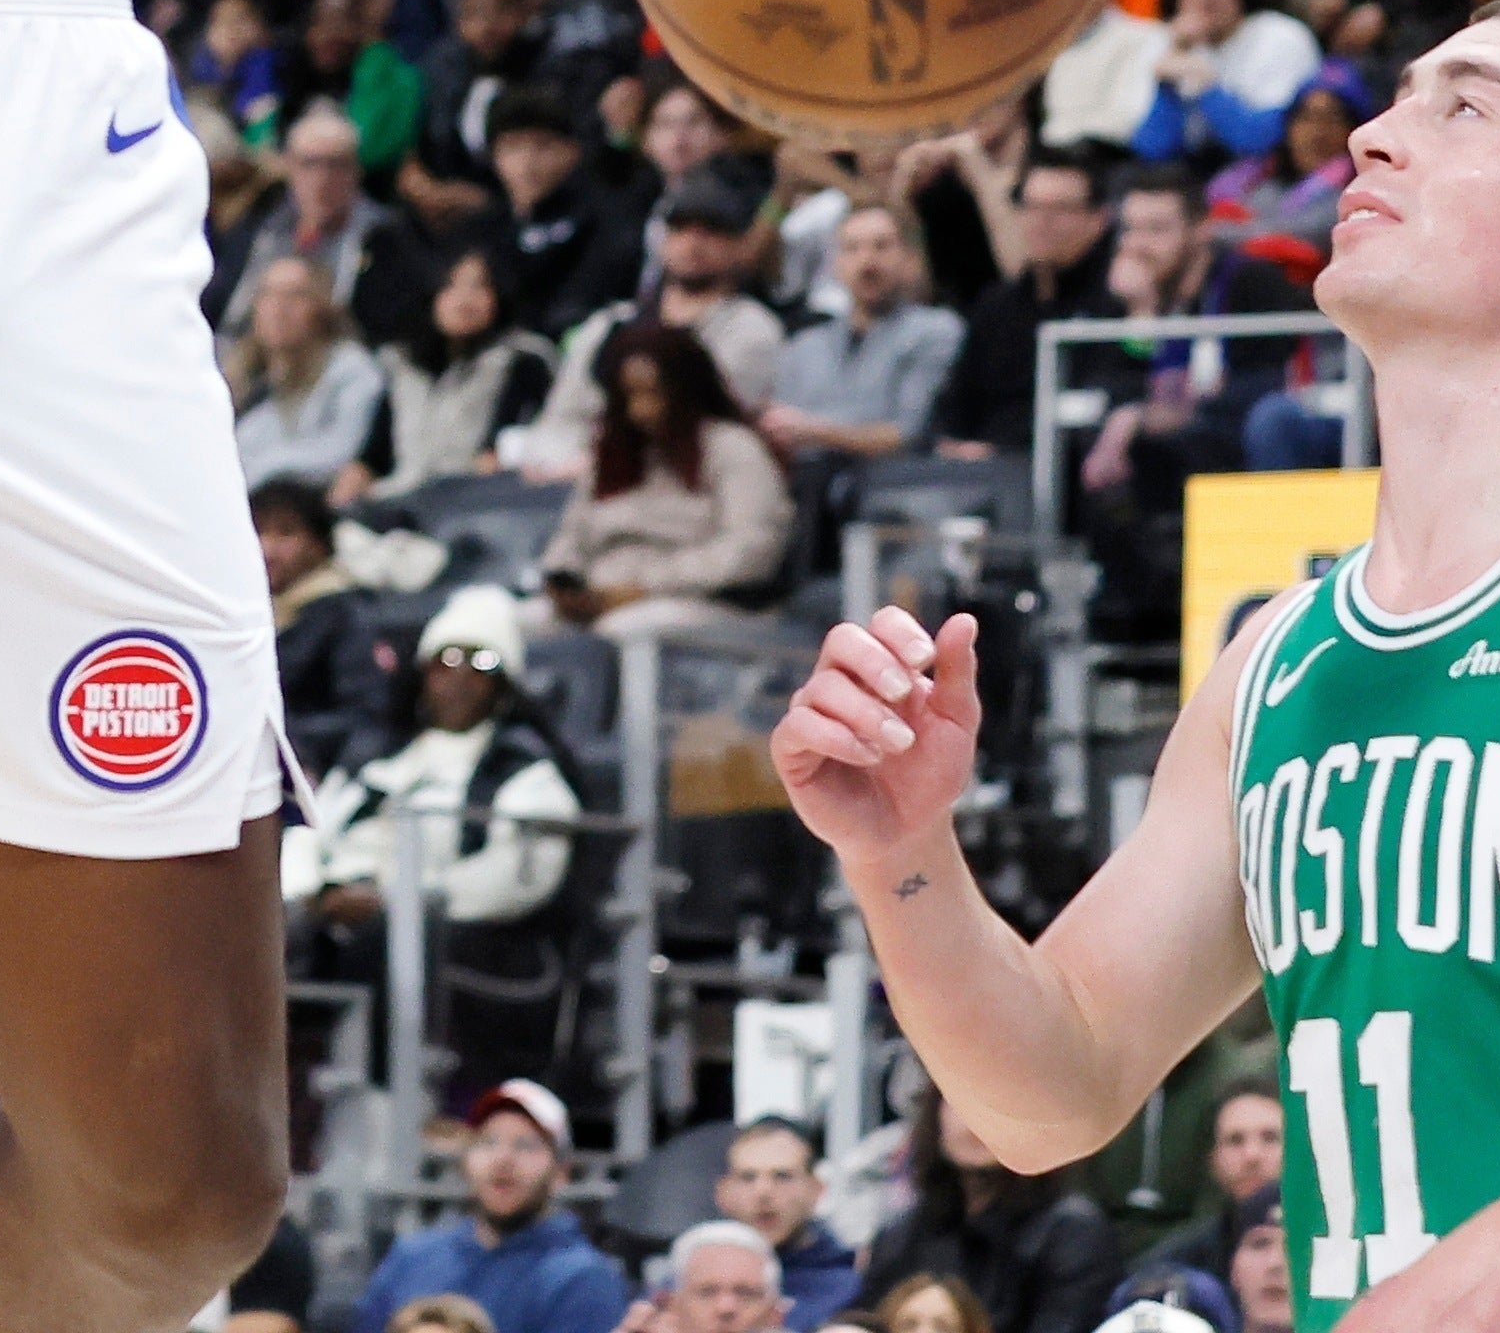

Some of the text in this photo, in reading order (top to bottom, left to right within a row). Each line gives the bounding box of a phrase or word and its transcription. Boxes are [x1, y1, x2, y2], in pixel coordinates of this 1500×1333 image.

[82, 683, 182, 709] DETROIT
[81, 709, 182, 738] PISTONS
[1289, 1010, 1441, 1300] 11
